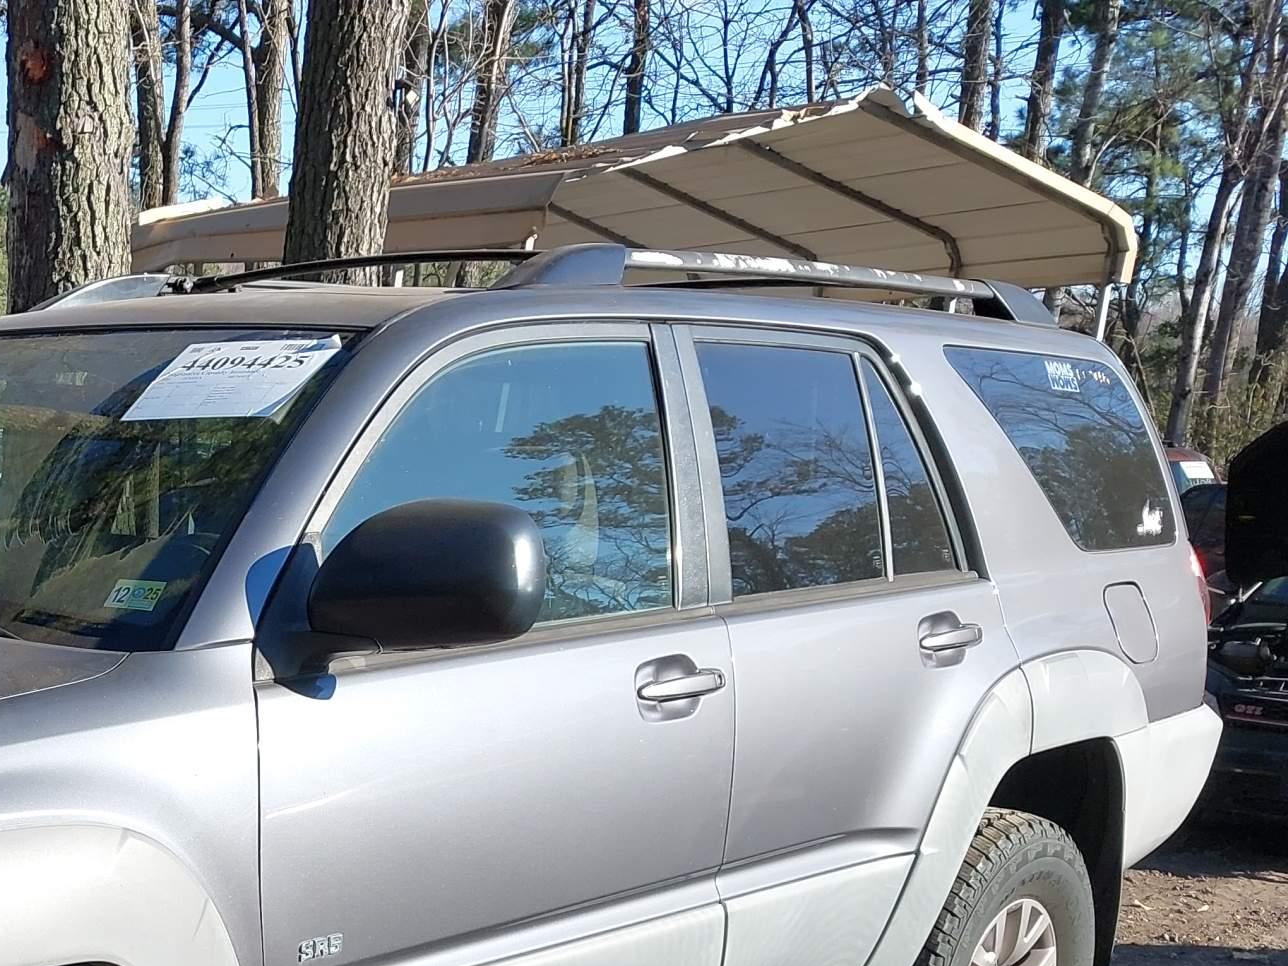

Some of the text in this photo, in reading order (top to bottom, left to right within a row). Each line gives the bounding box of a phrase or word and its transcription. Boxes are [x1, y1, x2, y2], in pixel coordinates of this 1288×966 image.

[183, 354, 311, 372] 44094425
[112, 587, 162, 603] 12 25
